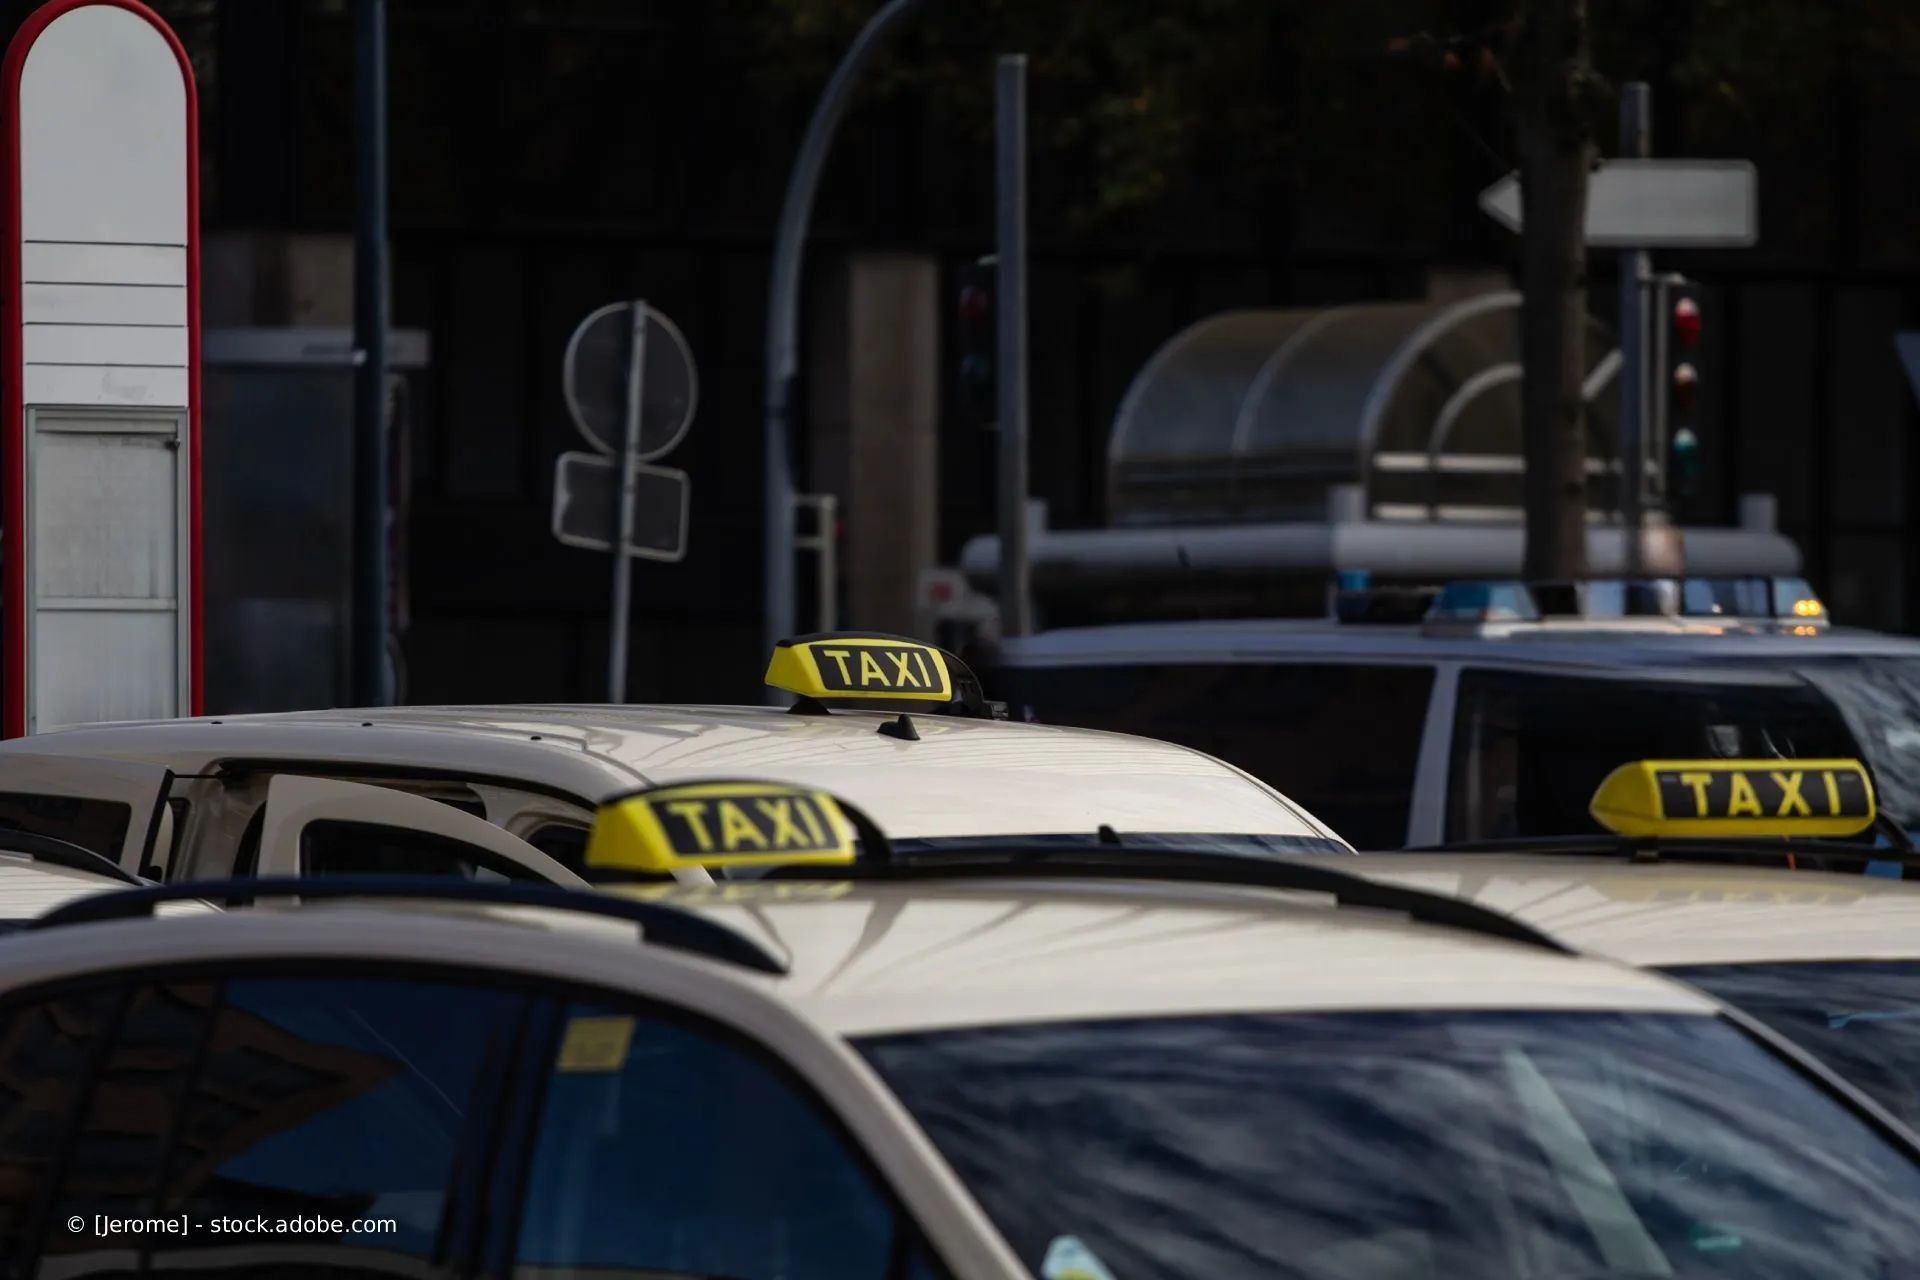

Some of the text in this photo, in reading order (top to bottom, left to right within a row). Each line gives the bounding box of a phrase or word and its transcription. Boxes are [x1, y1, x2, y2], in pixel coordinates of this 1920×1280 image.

[823, 650, 932, 688] TAXI
[1680, 771, 1841, 817] TAXI
[666, 798, 827, 850] TAXI
